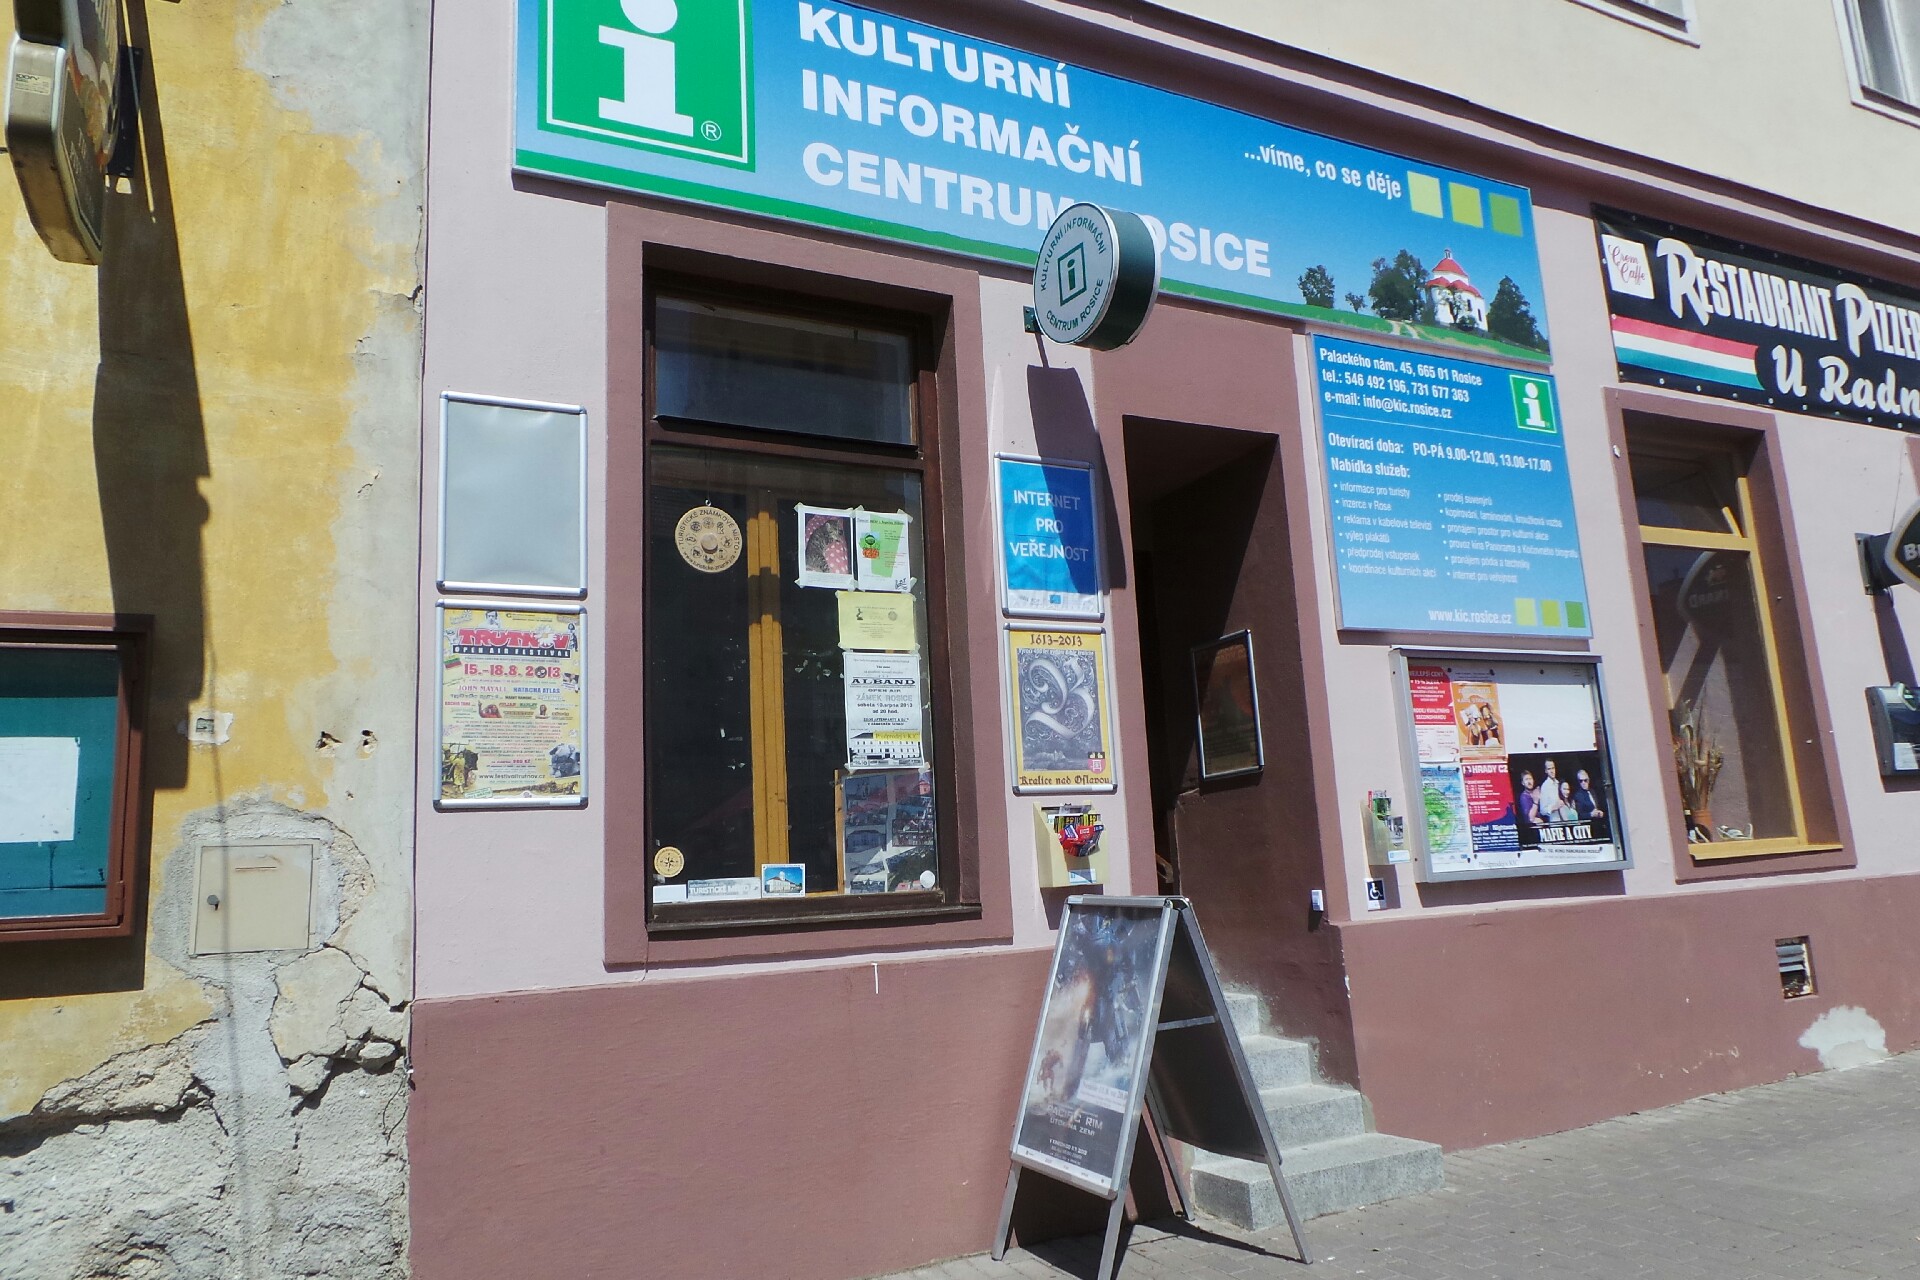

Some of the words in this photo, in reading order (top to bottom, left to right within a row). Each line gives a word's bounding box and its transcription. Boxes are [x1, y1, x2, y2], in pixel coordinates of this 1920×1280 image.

[800, 2, 1071, 109] KULTURNÍ
[802, 69, 1143, 187] INFORMAČNÍ
[1244, 145, 1311, 178] ...víme,
[1315, 160, 1337, 181] co
[1341, 167, 1362, 187] se
[1366, 170, 1402, 200] děje
[803, 141, 1075, 232] CENTRUM
[1141, 214, 1272, 278] SICE
[1656, 237, 1837, 341] RESTAURANT
[1046, 310, 1079, 331] CENTRUM
[1080, 278, 1104, 323] ROSICE
[1319, 347, 1372, 370] Palackého
[1374, 358, 1397, 374] nám.
[1401, 361, 1416, 378] 45,
[1417, 364, 1437, 380] 665
[1439, 367, 1450, 382] 01
[1452, 369, 1482, 387] Rosice
[1771, 345, 1807, 397] U
[1322, 368, 1343, 384] tel.:
[1344, 371, 1365, 388] 546
[1367, 375, 1386, 392] 492
[1387, 377, 1410, 397] 196,
[1411, 381, 1430, 397] 731
[1432, 384, 1449, 400] 677
[1452, 387, 1470, 404] 363
[1324, 390, 1361, 407] e-mail:
[1362, 394, 1452, 420] info@kic.rosice.cz
[1328, 431, 1374, 452] Otevírací
[1376, 438, 1404, 456] doba:
[1413, 440, 1444, 461] PO-PÁ
[1446, 446, 1499, 469] 9.00-12.00,
[1501, 453, 1553, 475] 13.00-17.00
[1331, 456, 1373, 475] Nabídka
[1375, 462, 1410, 479] služeb:
[1013, 489, 1081, 511] INTERNET
[1340, 481, 1375, 495] informace
[1376, 486, 1388, 496] pro
[1389, 487, 1411, 500] turisty
[1342, 498, 1367, 509] inzerce
[1374, 501, 1392, 511] Rose
[1036, 517, 1064, 535] PRO
[1344, 514, 1371, 526] reklama
[1345, 530, 1363, 544] výlep
[1009, 539, 1089, 562] VEŘEJNOST
[1904, 543, 1920, 562] B
[1428, 608, 1513, 625] www.kic.rosice.cz
[458, 628, 571, 650] TRUTNV
[1539, 826, 1566, 843] MAFIE
[1566, 826, 1574, 841] A
[1573, 824, 1593, 840] CITY
[1086, 1116, 1104, 1131] RIM
